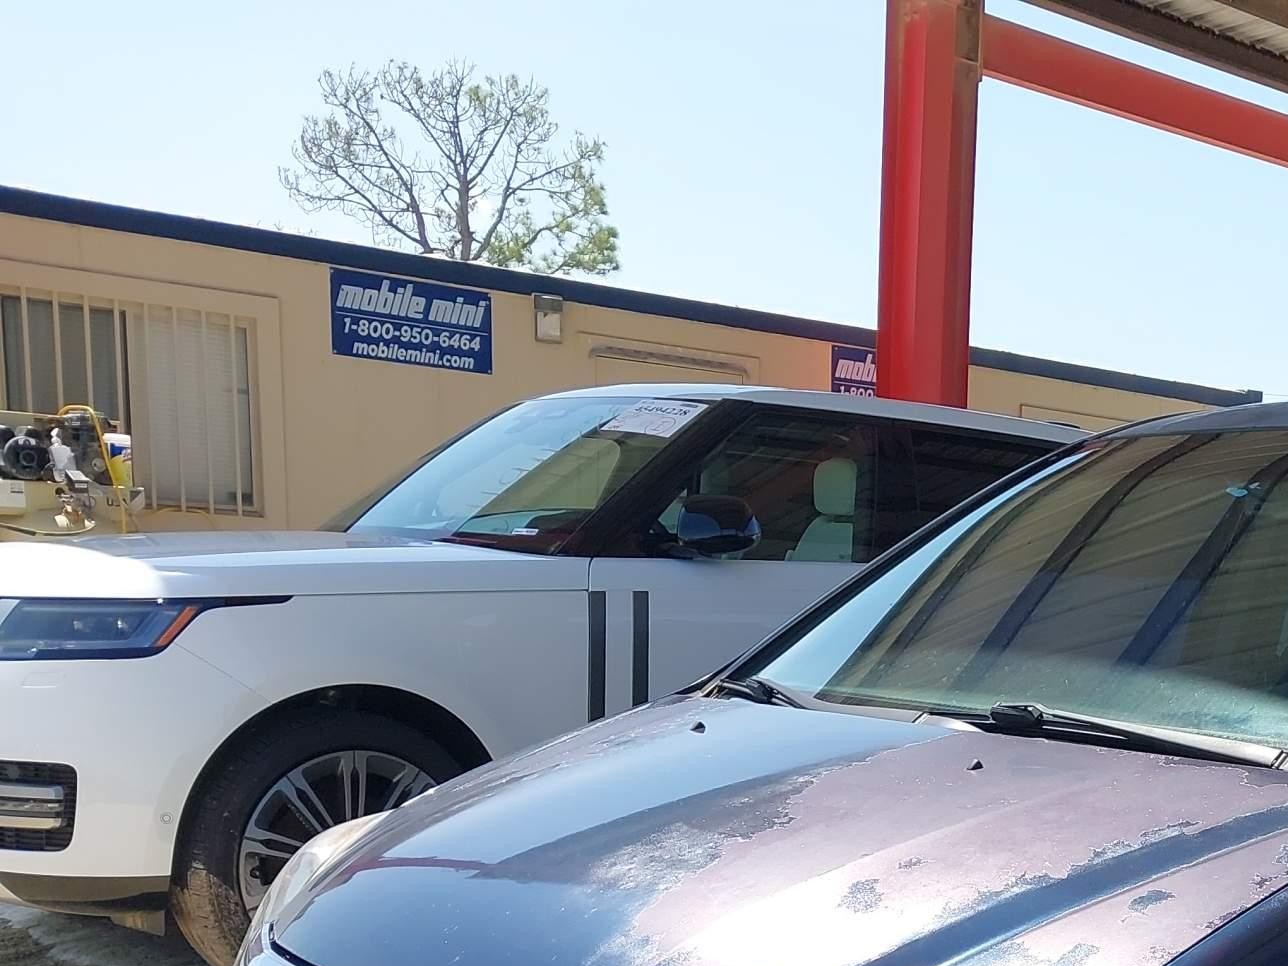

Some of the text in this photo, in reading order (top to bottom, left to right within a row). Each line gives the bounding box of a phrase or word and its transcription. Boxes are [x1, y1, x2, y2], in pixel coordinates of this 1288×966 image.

[336, 279, 486, 328] mobile mini
[343, 317, 481, 352] 1-800-950-6464
[352, 341, 475, 370] mobilemini.com
